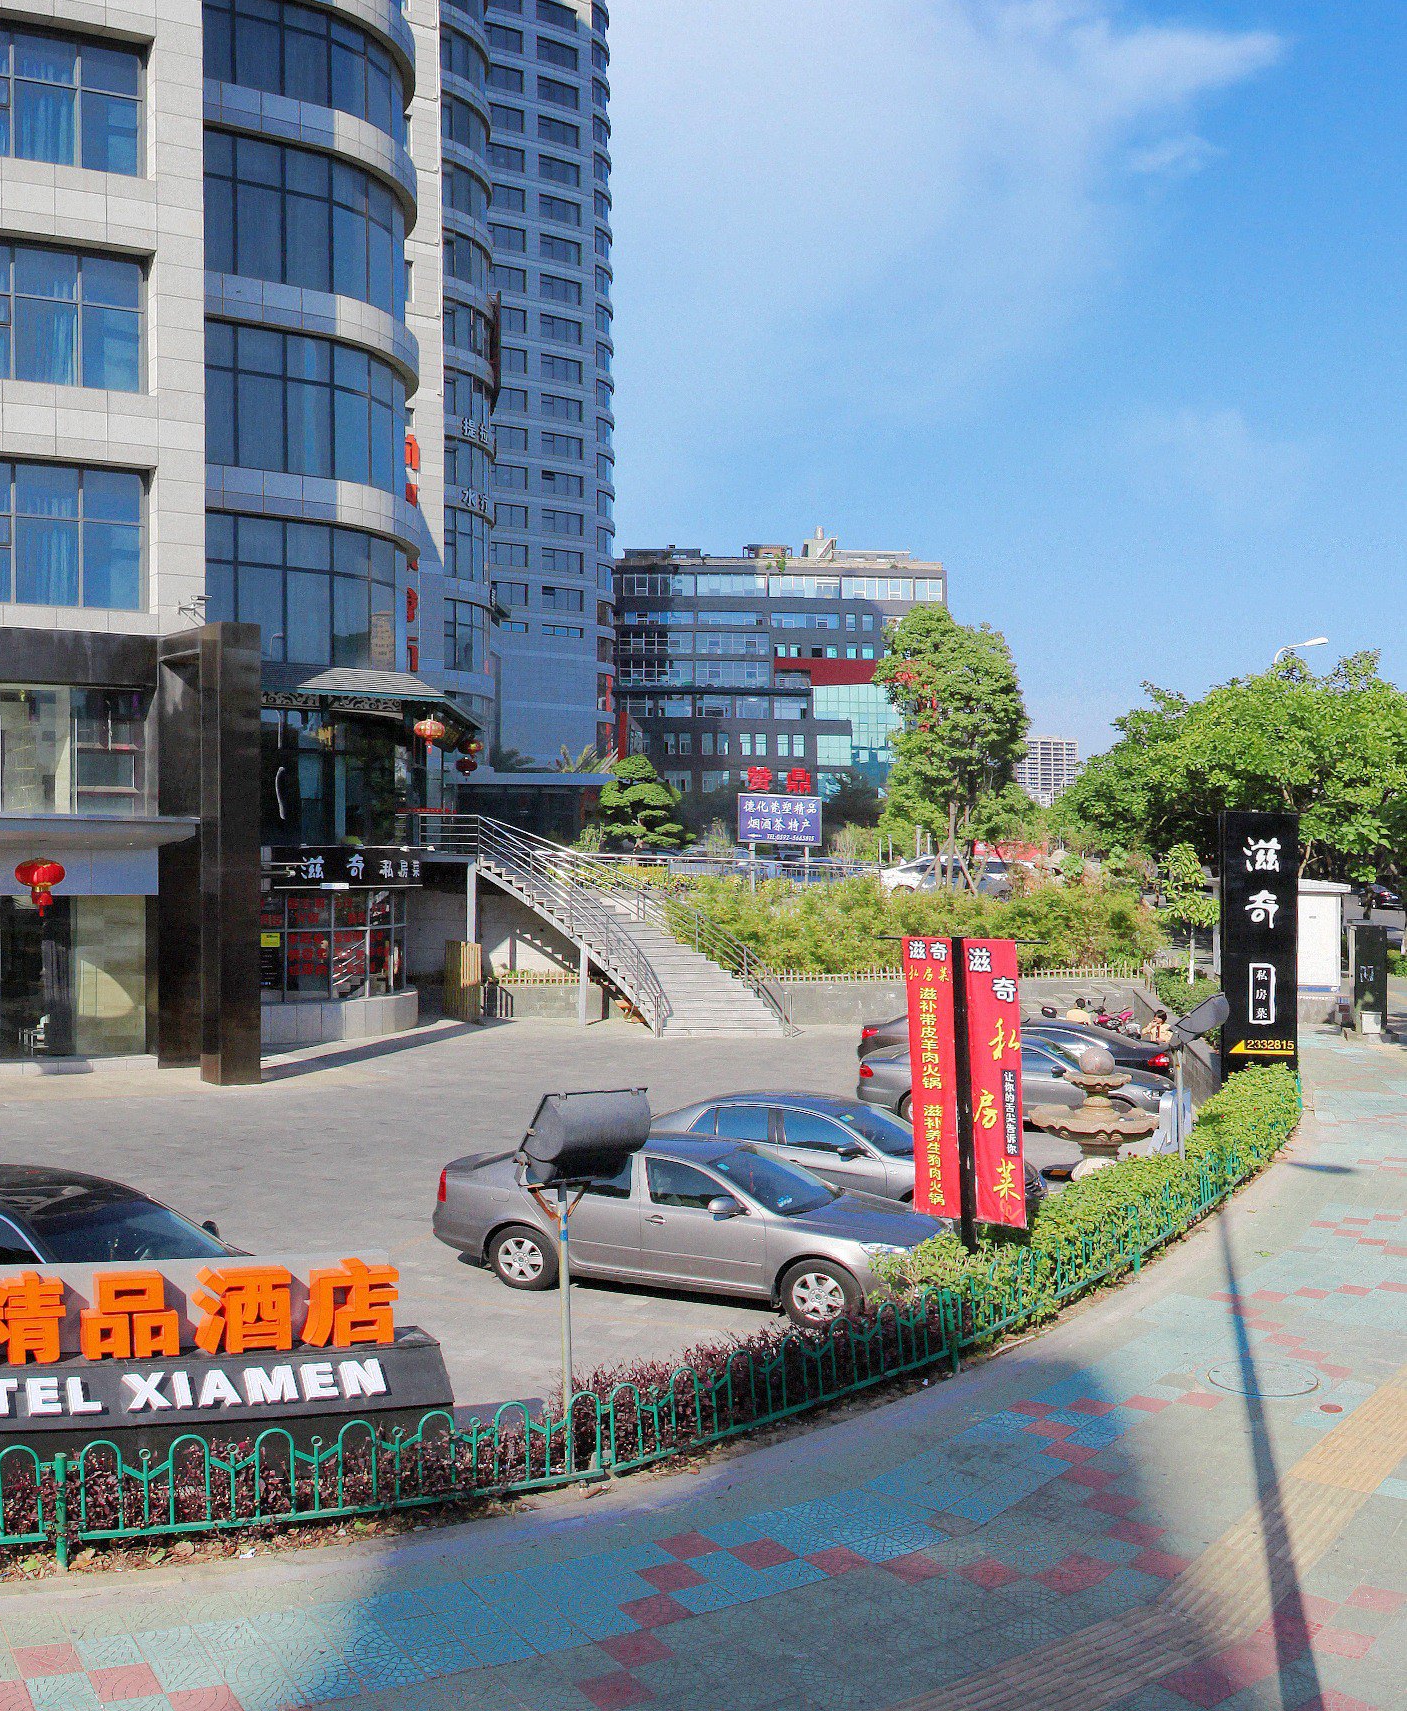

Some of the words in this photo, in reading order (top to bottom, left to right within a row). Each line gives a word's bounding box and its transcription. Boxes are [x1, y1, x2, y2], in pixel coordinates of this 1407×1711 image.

[1243, 837, 1282, 929] 滋奇
[908, 940, 948, 962] 滋奇
[968, 947, 1018, 1004] 滋奇
[1256, 969, 1268, 1019] 私房菜
[919, 987, 941, 1089] 滋补带皮羊肉火锅
[1247, 1040, 1294, 1050] 2332815
[120, 1358, 388, 1413] XIAMEN
